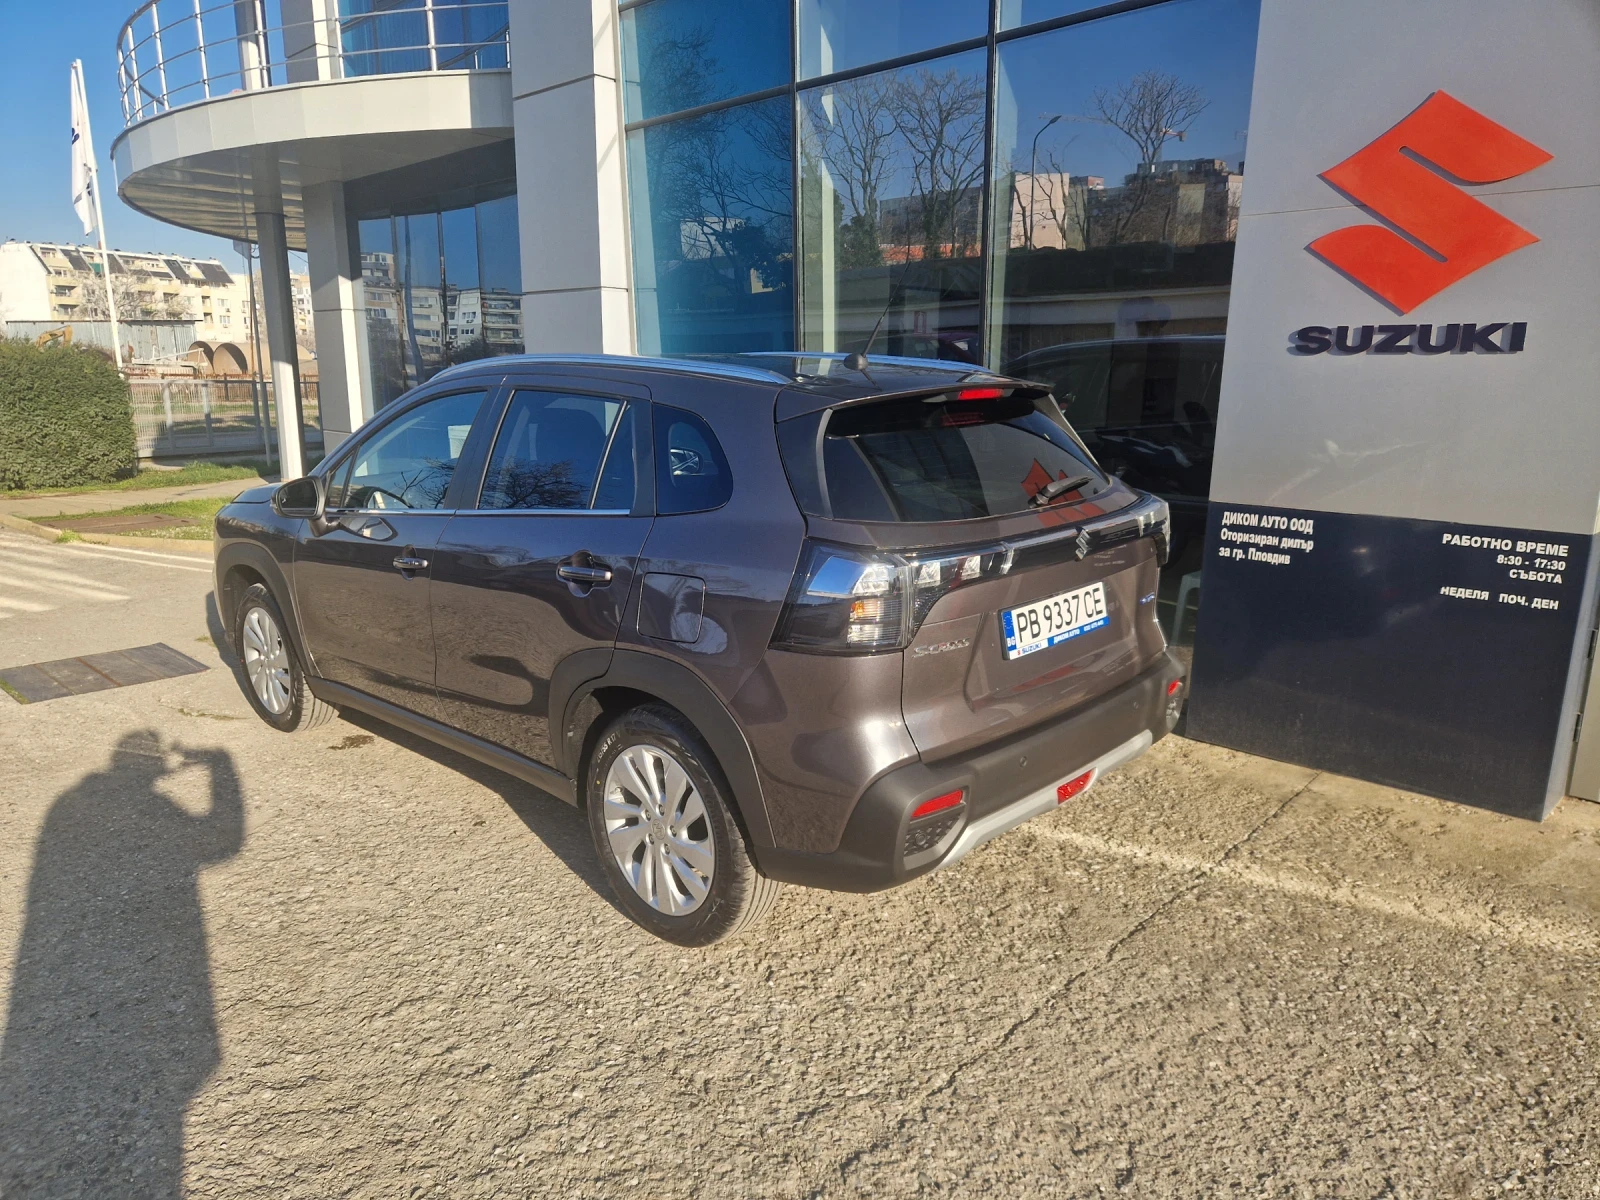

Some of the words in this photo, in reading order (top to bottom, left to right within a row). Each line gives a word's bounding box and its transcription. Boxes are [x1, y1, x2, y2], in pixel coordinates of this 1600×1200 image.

[1294, 321, 1528, 353] SUZUKI
[1222, 511, 1259, 526] ДИКОМ
[1260, 515, 1288, 530] АУТО
[1290, 518, 1314, 535] ООД
[1220, 528, 1279, 547] Оторизиран
[1280, 537, 1314, 553] дилър
[1442, 533, 1512, 551] РАБОТНО
[1516, 541, 1569, 557] ВРЕМЕ
[1218, 547, 1231, 557] за
[1232, 548, 1246, 561] гр.
[1247, 547, 1291, 565] Пловдив
[1496, 554, 1523, 566] 8:30
[1533, 557, 1566, 571] 17:30
[1509, 569, 1563, 584] СЪБОТА
[1440, 586, 1490, 601] НЕДЕЛЯ
[1498, 593, 1529, 606] ПОЧ.
[1531, 597, 1560, 610] ДЕН
[1043, 594, 1080, 633] 9337
[1006, 637, 1016, 647] BG
[1021, 642, 1042, 655] SUZUKI
